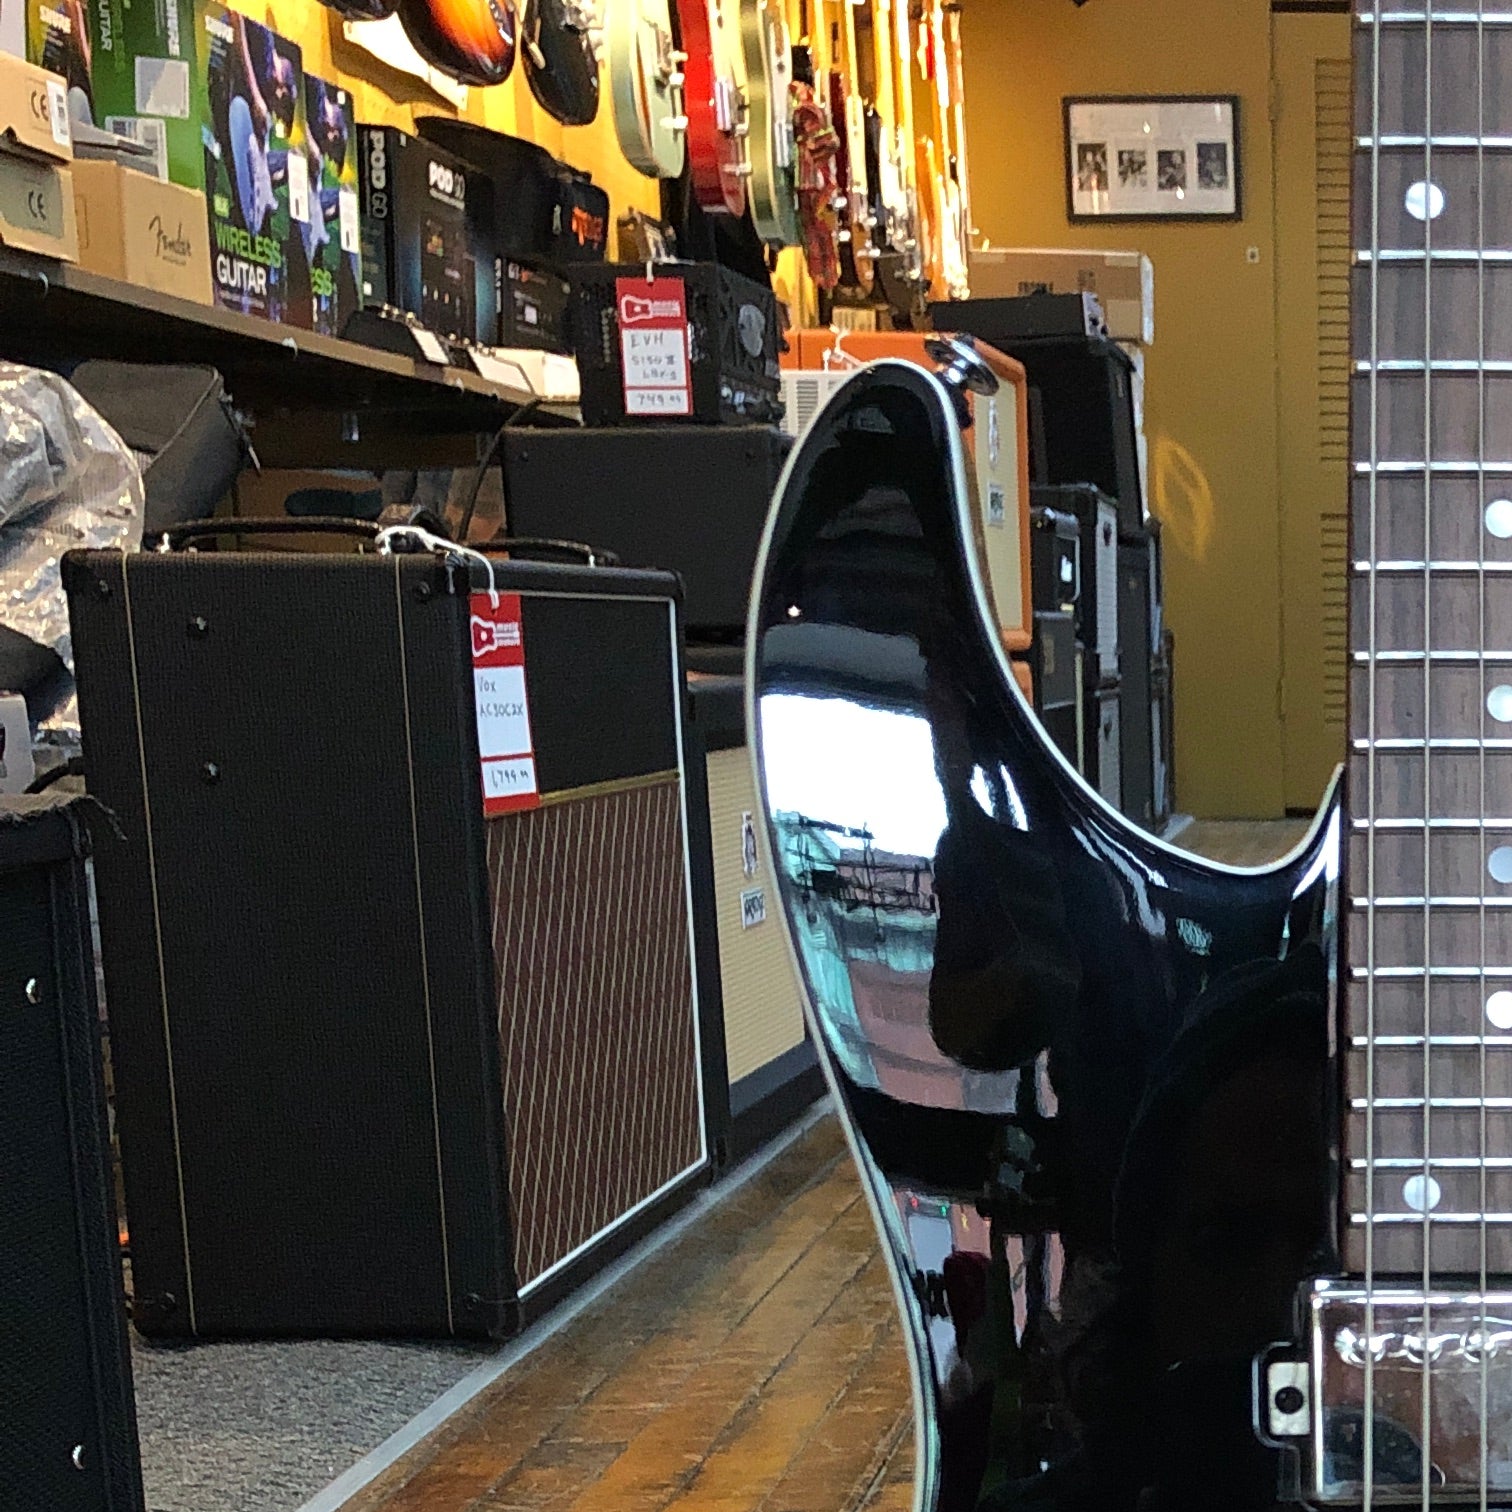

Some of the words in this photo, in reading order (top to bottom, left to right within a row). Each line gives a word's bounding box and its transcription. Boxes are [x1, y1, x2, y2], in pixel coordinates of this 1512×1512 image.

[369, 129, 386, 189] POD
[428, 160, 454, 194] POD
[214, 220, 282, 269] WIRELESS
[216, 252, 268, 297] GUITAR
[630, 332, 664, 348] EVH
